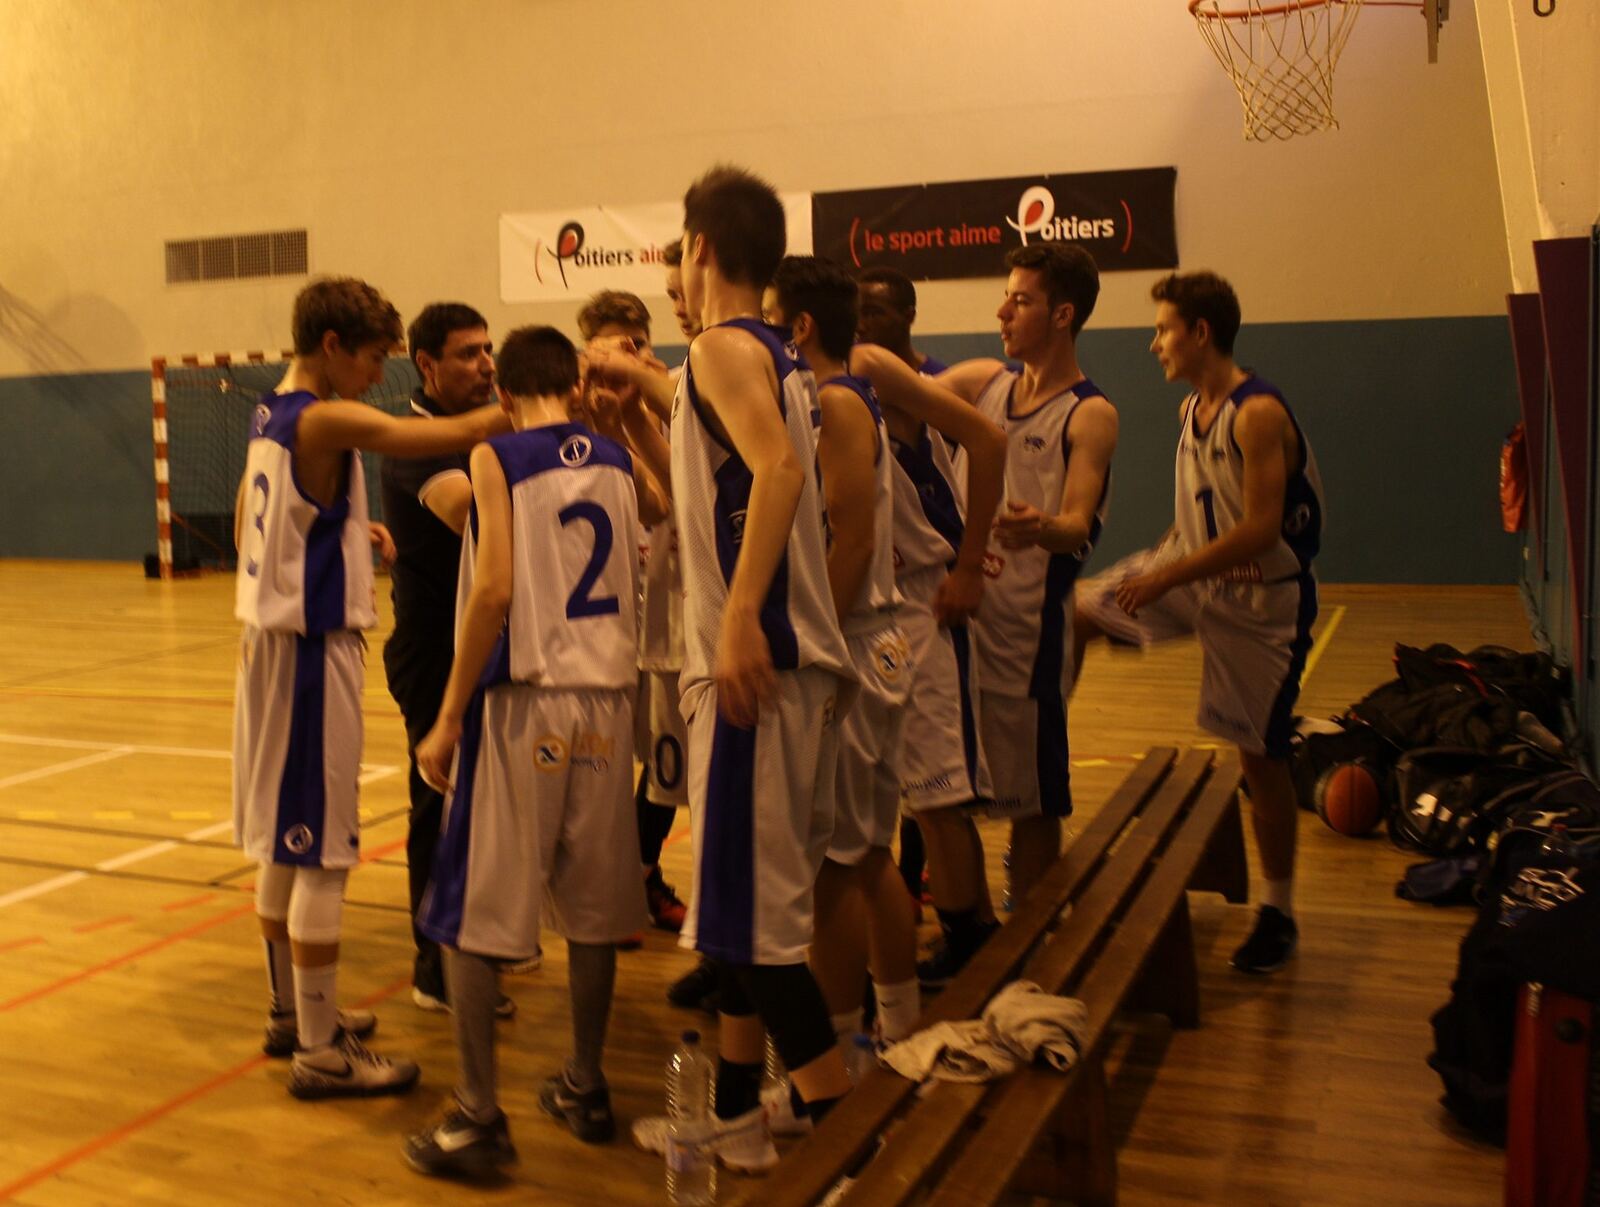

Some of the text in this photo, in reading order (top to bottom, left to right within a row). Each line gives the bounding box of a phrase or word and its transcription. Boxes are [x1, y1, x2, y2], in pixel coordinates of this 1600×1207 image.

[864, 184, 1116, 255] le sport aime Poitiers
[546, 221, 634, 290] Poitiers
[558, 501, 620, 619] 2
